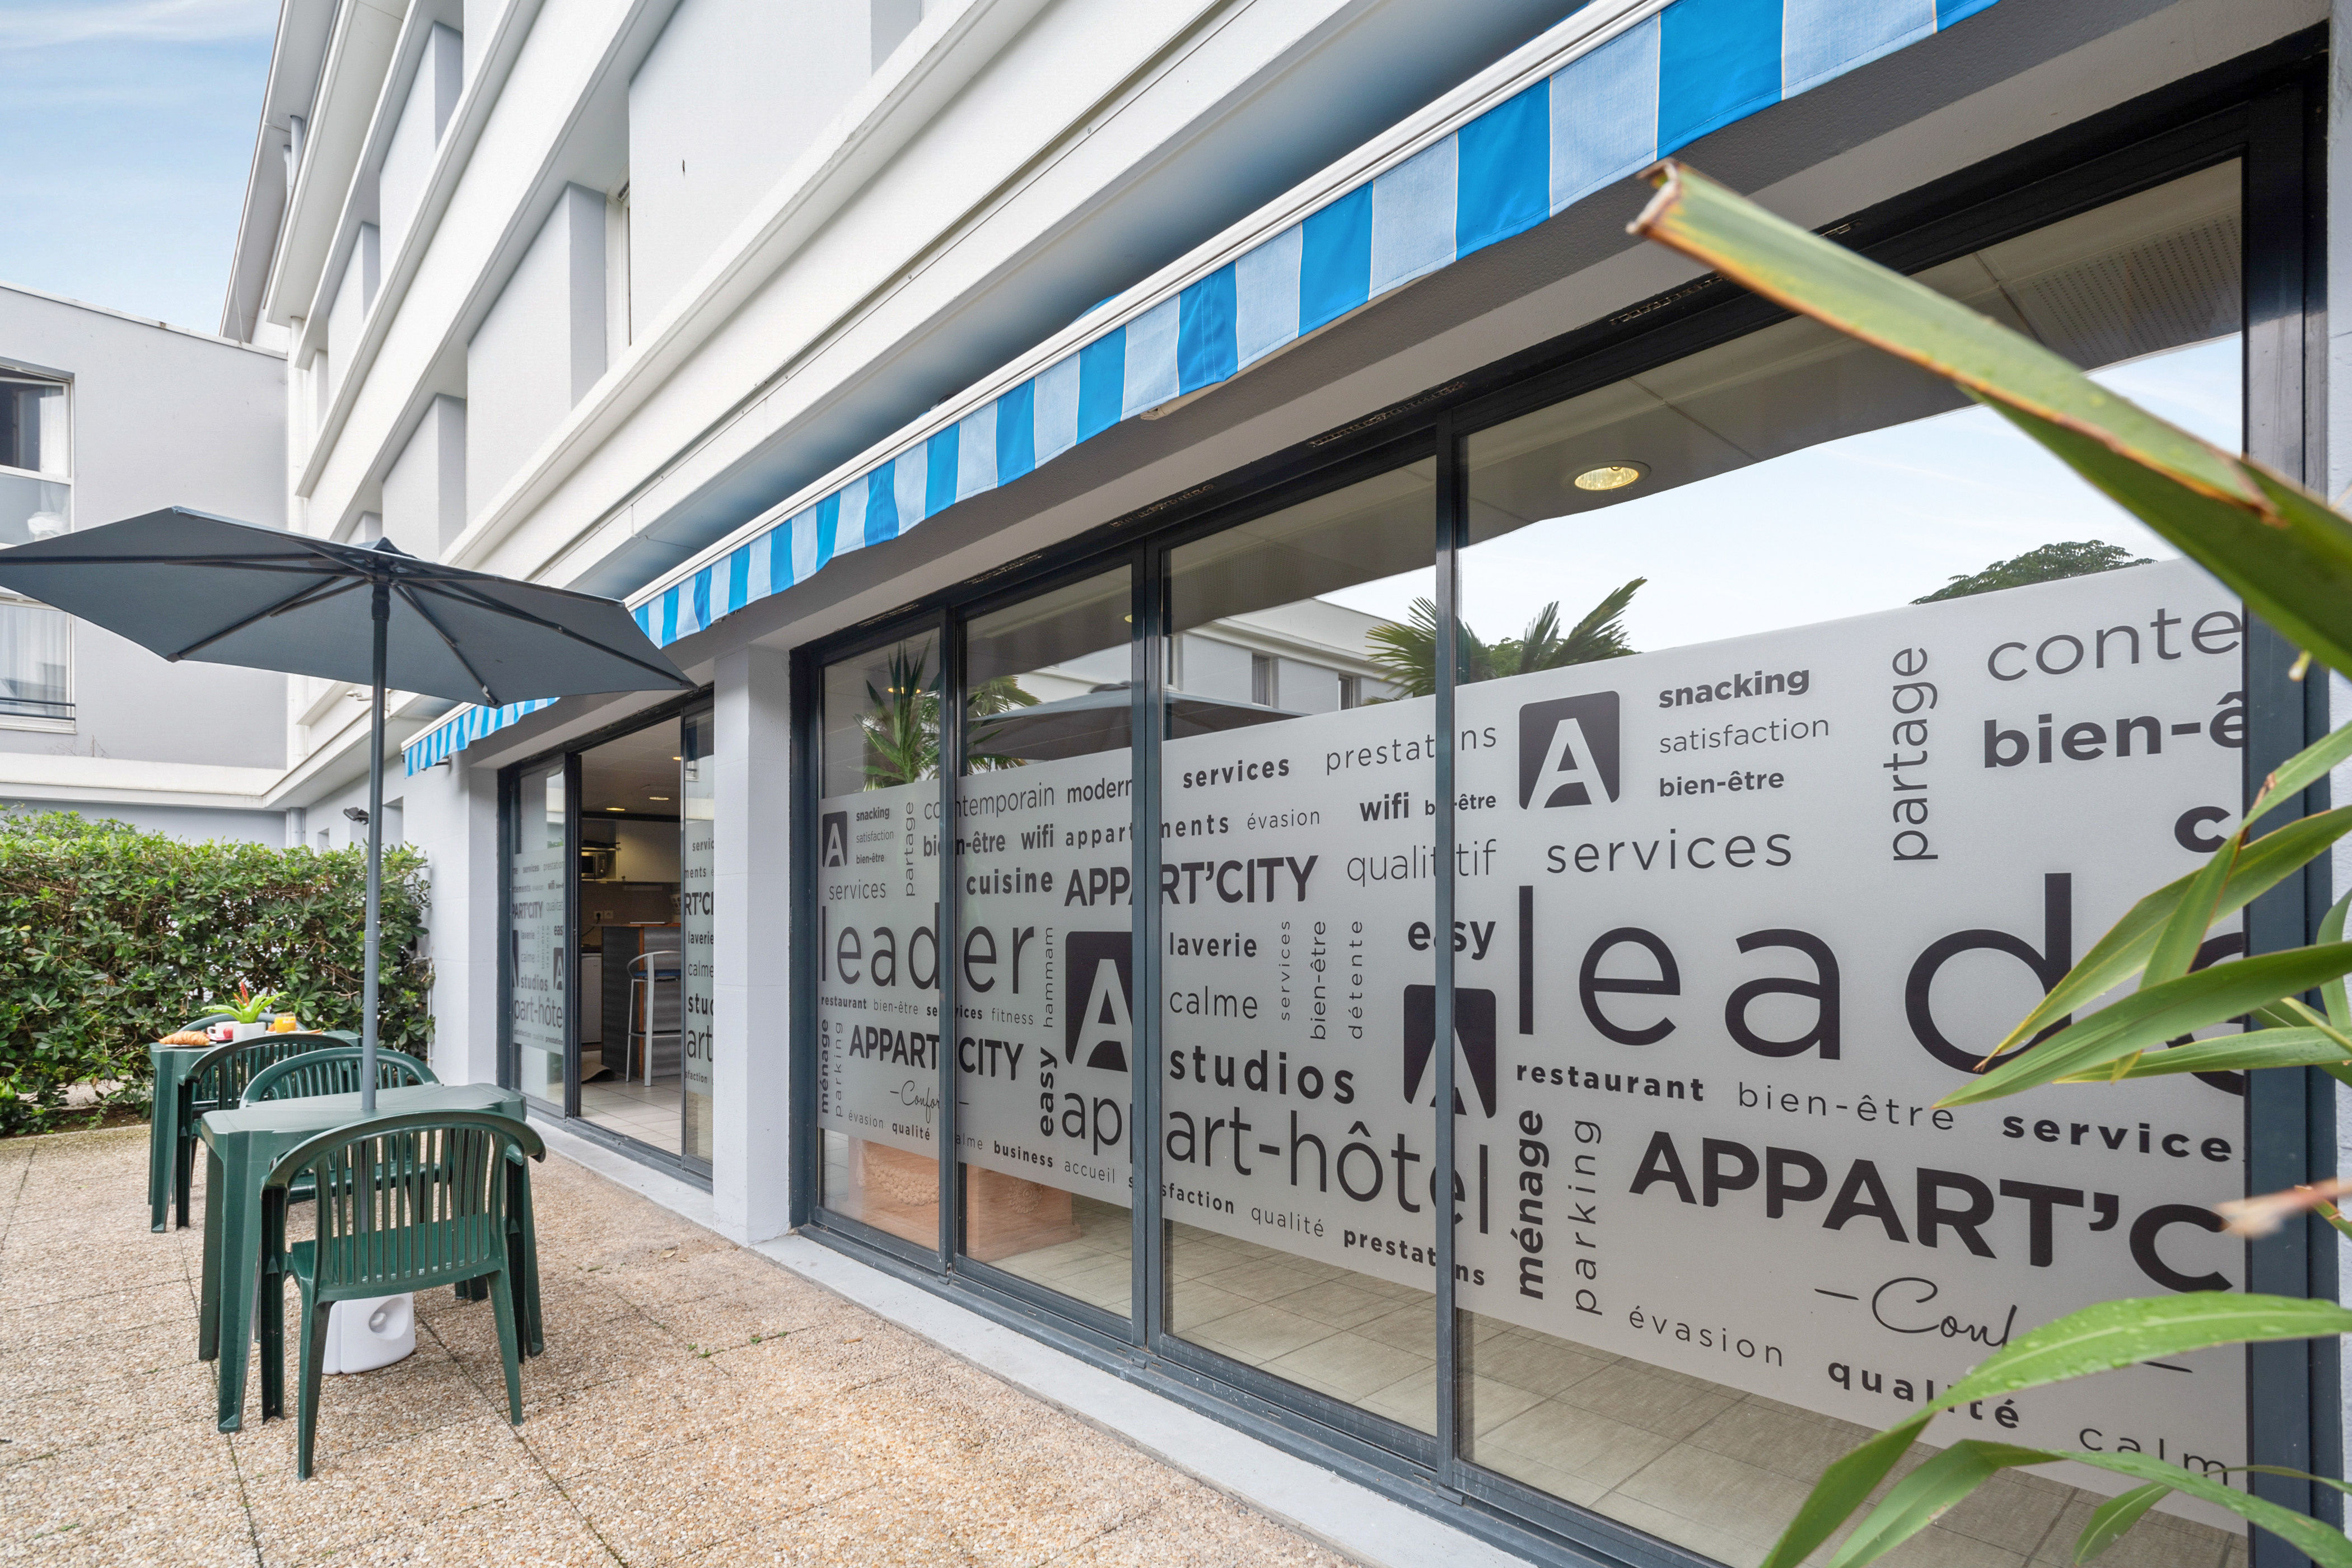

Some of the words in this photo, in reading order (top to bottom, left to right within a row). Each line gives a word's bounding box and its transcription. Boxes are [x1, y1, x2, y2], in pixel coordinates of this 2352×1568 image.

[1987, 608, 2243, 681] conte
[1659, 669, 1809, 708] snacking
[1183, 758, 1289, 788] services
[1327, 726, 1496, 776] prestatns
[1527, 718, 1611, 810] A
[1660, 718, 1830, 754] satisfaction
[1884, 647, 1938, 861] partage
[856, 807, 890, 822] snacking
[1660, 771, 1784, 797] bien-être
[856, 829, 894, 843] satisfaction
[904, 802, 916, 897] partage
[923, 830, 1006, 857] bin-être
[1021, 824, 1054, 850] wifi
[1247, 808, 1320, 830] évasion
[1360, 792, 1410, 822] wifi
[1547, 828, 1791, 874] services
[829, 879, 886, 900] services
[856, 853, 884, 864] bien-être
[966, 867, 1053, 896] cuisine
[1065, 855, 1319, 907] APPRT'CITY
[688, 931, 714, 944] laverie
[822, 902, 1034, 994] leader
[1170, 932, 1257, 958] laverie
[1408, 920, 1496, 960] esy
[521, 975, 548, 991] studios
[1043, 927, 1053, 1028] hammam
[1279, 921, 1290, 1021] services
[1310, 921, 1326, 1040] bien-être
[1348, 921, 1362, 1039] détente
[821, 995, 867, 1009] restaurant
[874, 998, 918, 1015] bien-être
[992, 1007, 1034, 1025] fitness
[1170, 986, 1258, 1019] calme
[820, 1019, 830, 1114] ménage
[834, 1023, 843, 1118] parking
[1040, 1047, 1058, 1137] easy
[1170, 1046, 1355, 1104] studios
[1517, 1062, 1704, 1102] restaurant
[1739, 1082, 1954, 1130] bien-être
[848, 1110, 883, 1128] évasion
[893, 1122, 930, 1141] qualité
[994, 1141, 1053, 1168] business
[1065, 1161, 1115, 1184] accueil
[1251, 1206, 1324, 1237] qualité
[1344, 1229, 1485, 1286] prestatns
[1510, 1110, 1550, 1300] ménage
[1568, 1120, 1603, 1315] parking
[1629, 1305, 1782, 1367] évasion
